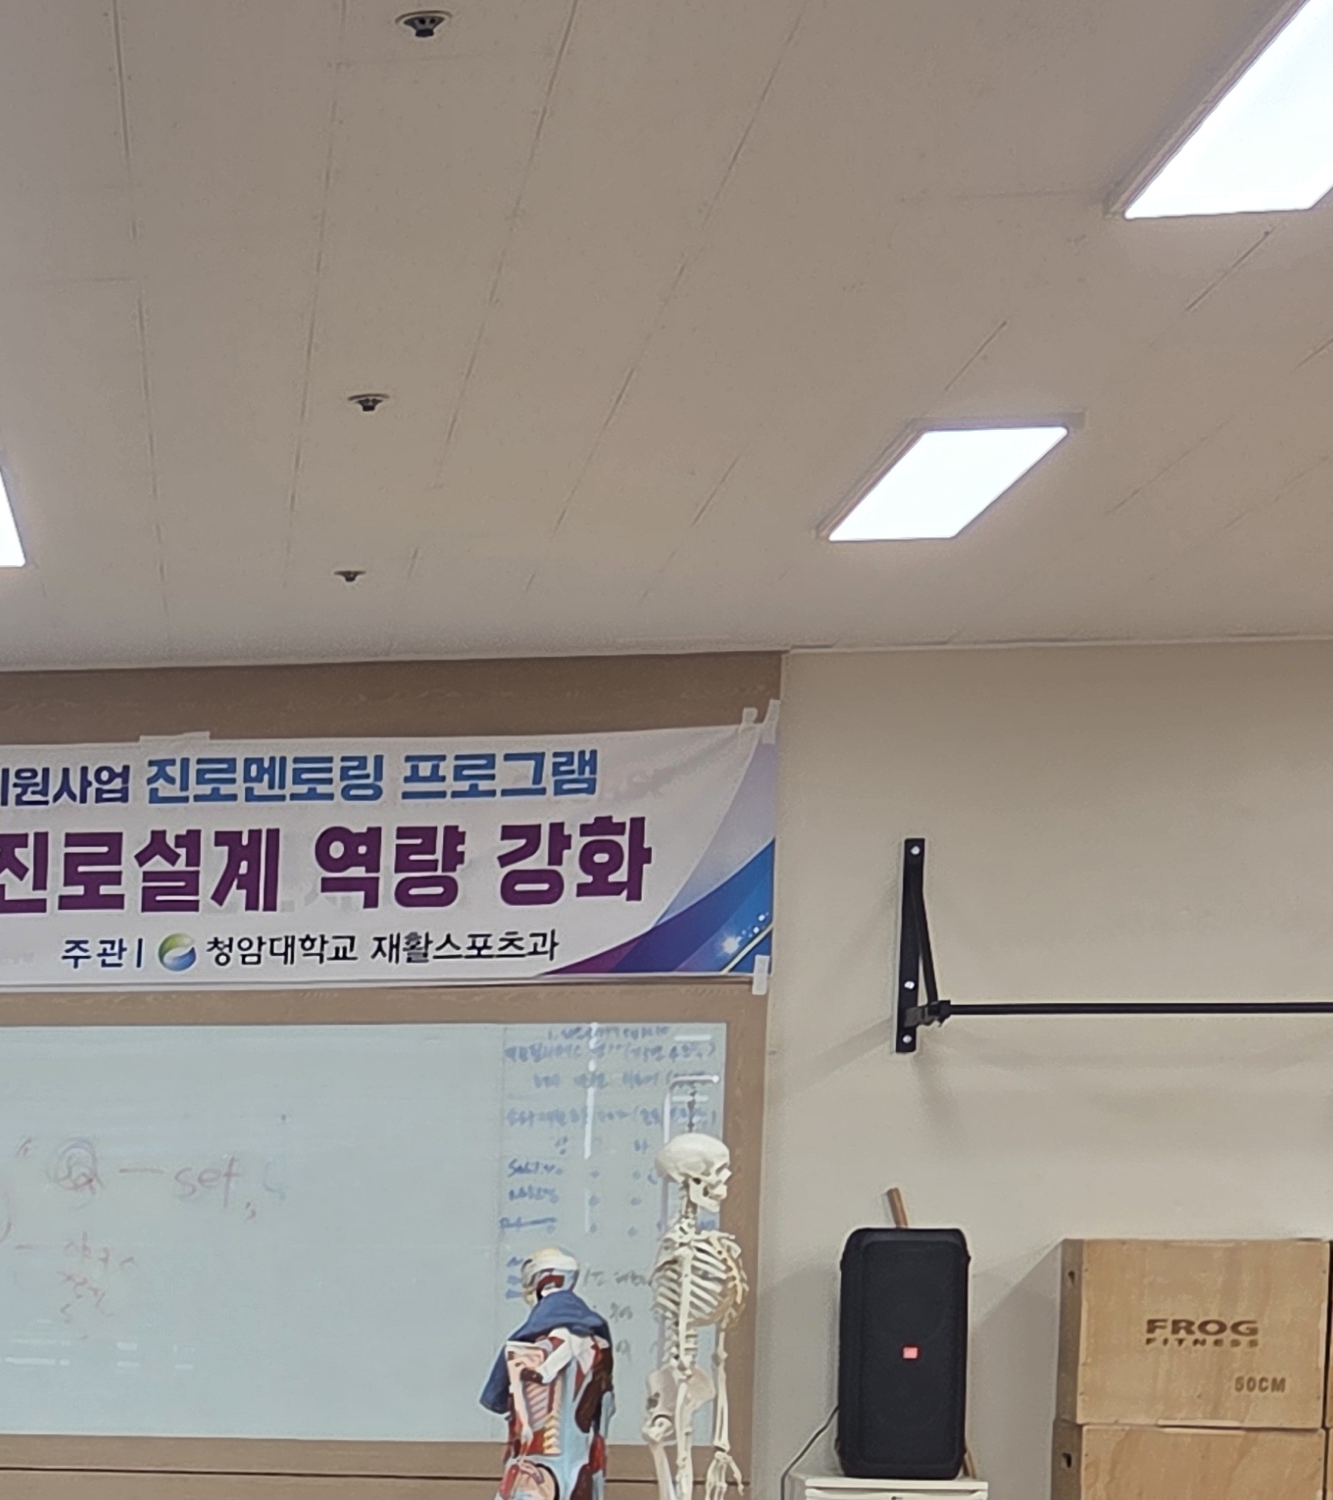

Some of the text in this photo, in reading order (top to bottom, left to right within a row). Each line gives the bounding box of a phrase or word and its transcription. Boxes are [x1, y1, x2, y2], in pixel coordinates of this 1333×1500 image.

[146, 754, 384, 805] 진로멘토링
[401, 748, 598, 800] 프로그램
[314, 824, 467, 910] 역량
[496, 815, 653, 906] 강화
[61, 937, 128, 969] 주관
[206, 933, 358, 967] 청암대학교
[370, 928, 560, 965] 재활스포츠과
[1145, 1337, 1259, 1348] FITNESS
[1146, 1318, 1259, 1337] FROG
[1234, 1375, 1286, 1393] 50CM
